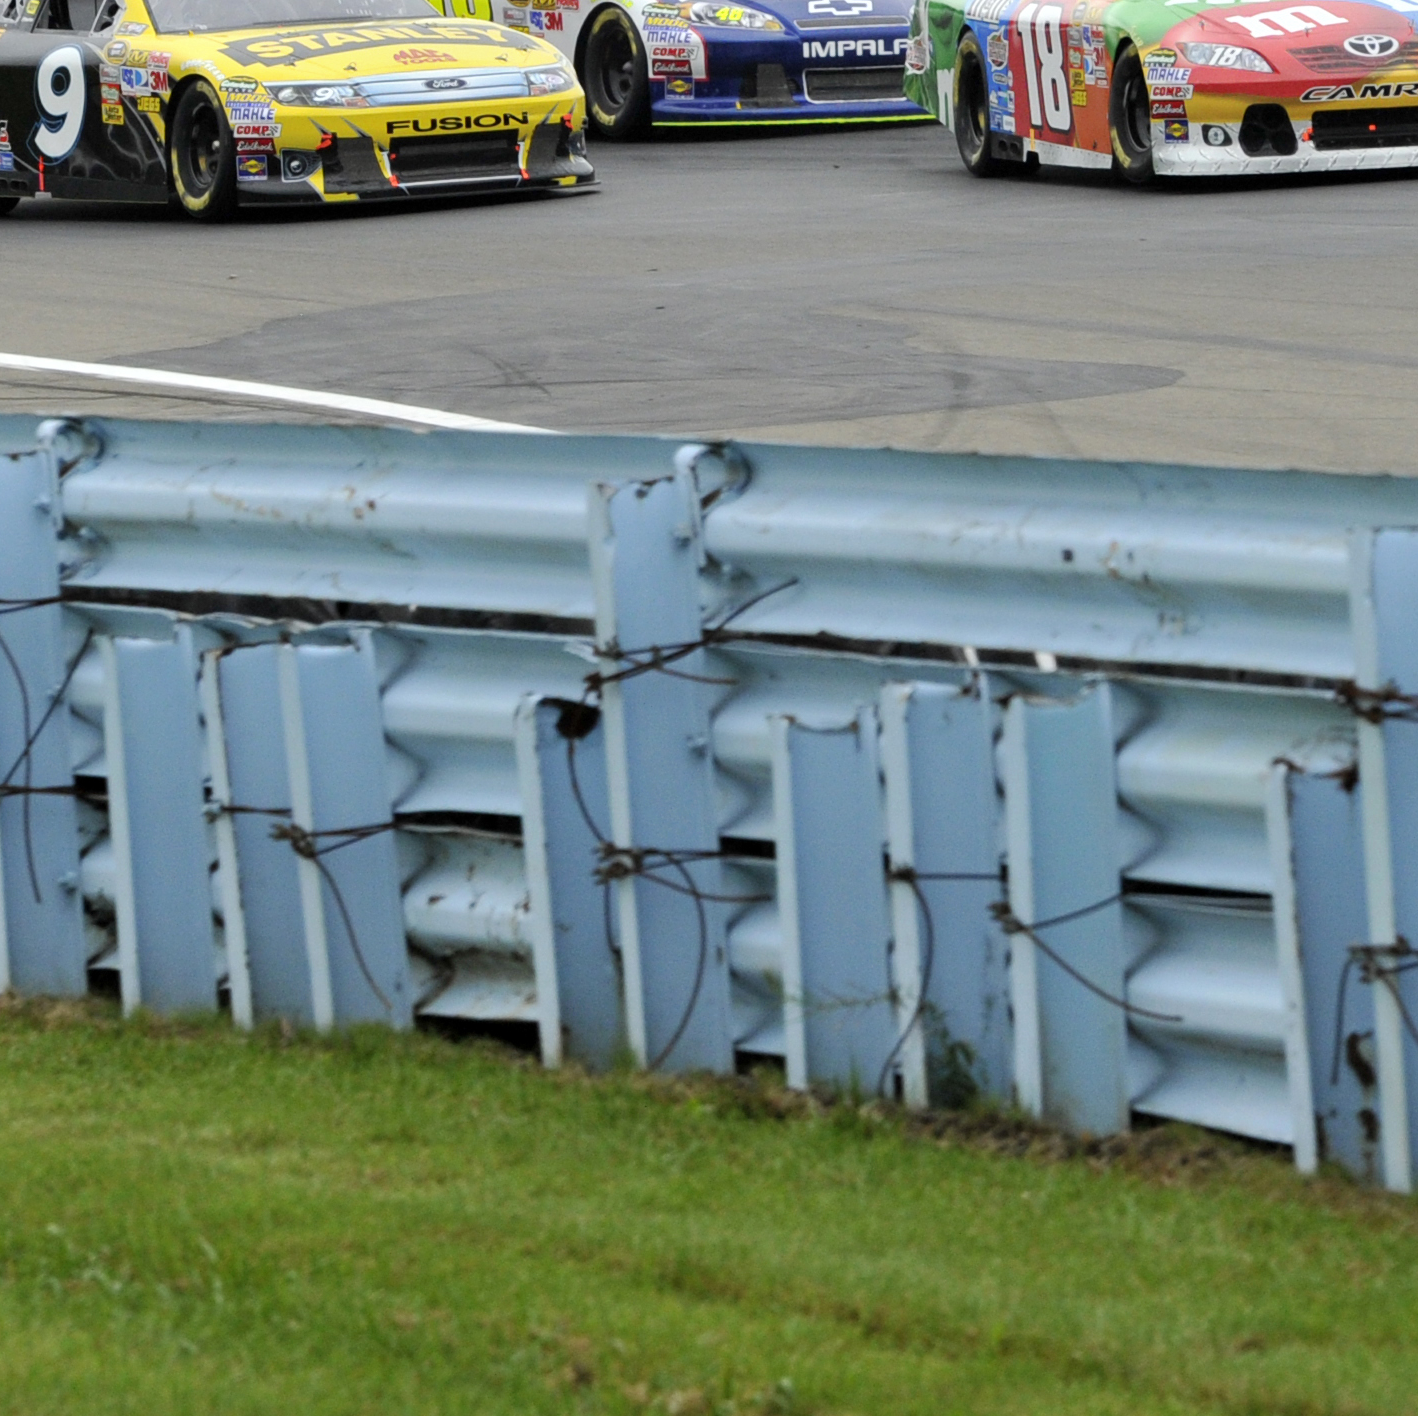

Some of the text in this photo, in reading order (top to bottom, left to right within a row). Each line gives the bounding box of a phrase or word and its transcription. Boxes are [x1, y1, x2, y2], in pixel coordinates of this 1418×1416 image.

[715, 7, 744, 21] 48
[545, 12, 563, 31] 3M
[1225, 5, 1349, 38] m
[246, 26, 509, 59] STANLEY
[647, 31, 692, 43] MAHLE
[393, 48, 446, 62] MAC
[652, 47, 686, 56] COMP
[1208, 47, 1243, 66] 18
[401, 54, 458, 65] TOOLS
[1017, 0, 1072, 132] 18
[149, 70, 168, 92] 3M
[1147, 68, 1189, 81] MAHLE
[432, 79, 458, 88] Ford
[228, 93, 271, 102] MOOG
[312, 87, 332, 102] 9
[1152, 87, 1182, 96] COMP
[34, 46, 85, 158] 9
[137, 96, 161, 112] JEGS
[231, 108, 275, 120] MAHLE
[236, 125, 269, 135] COMP
[386, 112, 529, 134] FUSION
